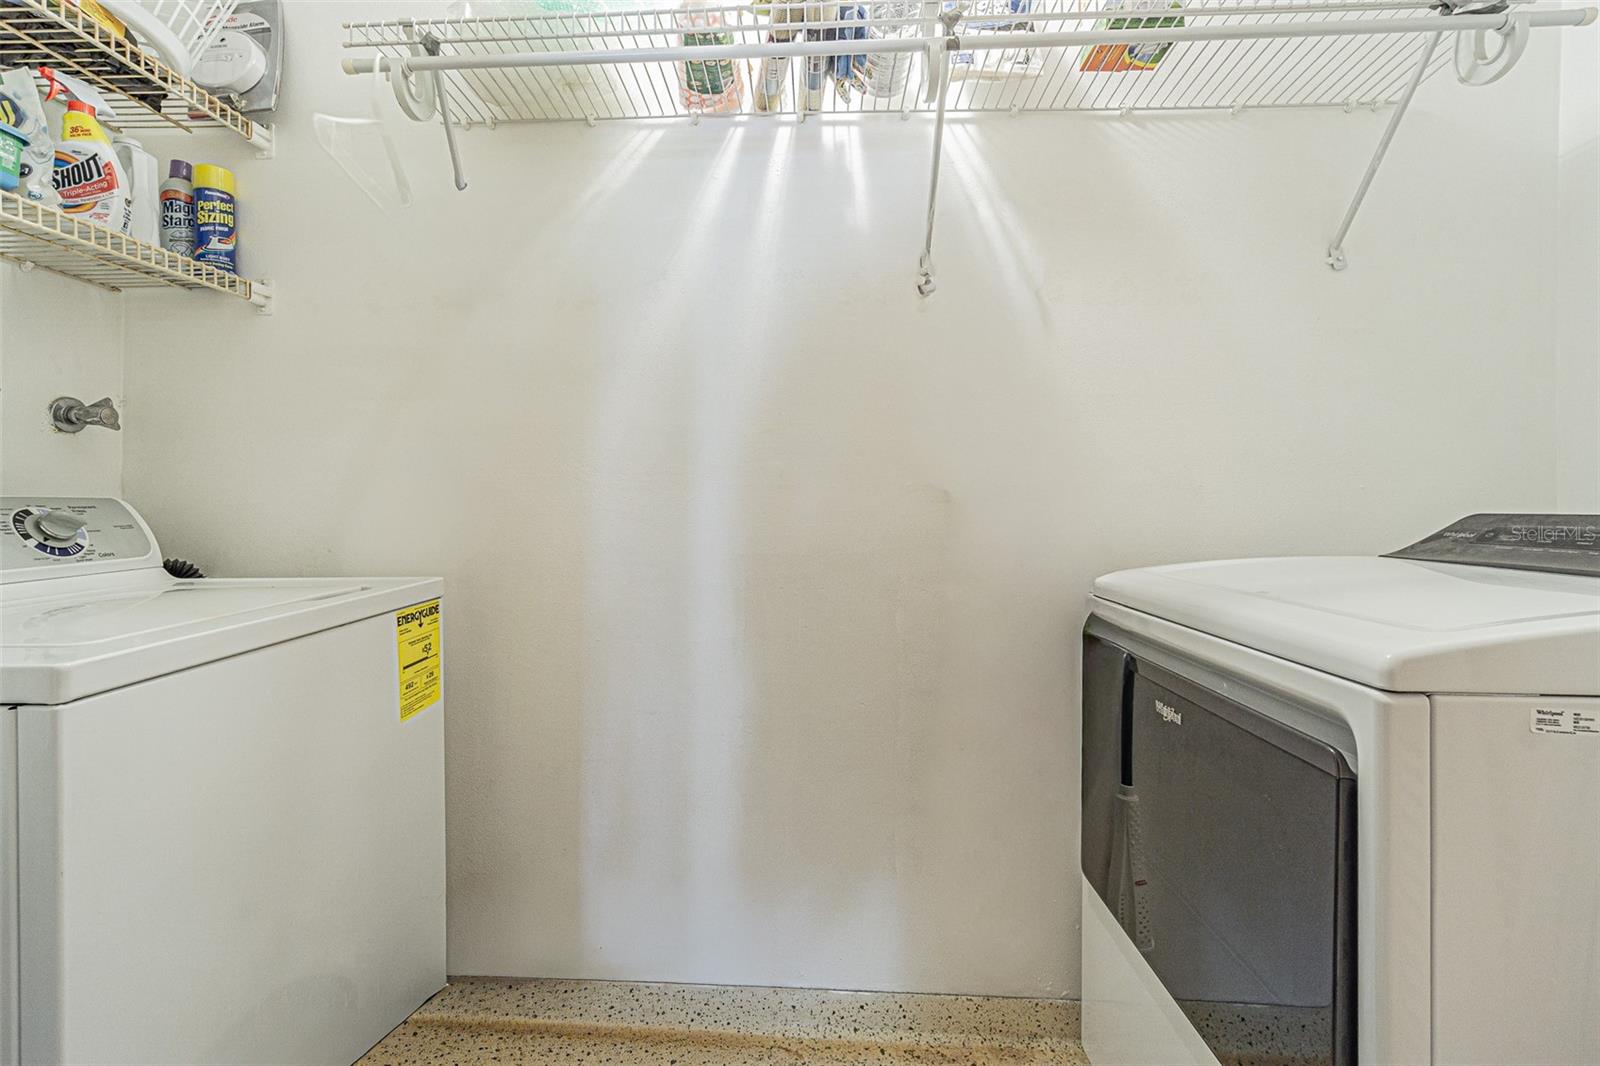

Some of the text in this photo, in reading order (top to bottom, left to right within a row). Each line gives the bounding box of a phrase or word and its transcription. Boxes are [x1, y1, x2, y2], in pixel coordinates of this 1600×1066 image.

[52, 152, 103, 190] SHOUT
[63, 180, 109, 198] Triple-Acting
[197, 200, 234, 213] Perfect
[197, 210, 234, 228] Sizing
[1536, 709, 1565, 717] Whirlpool
